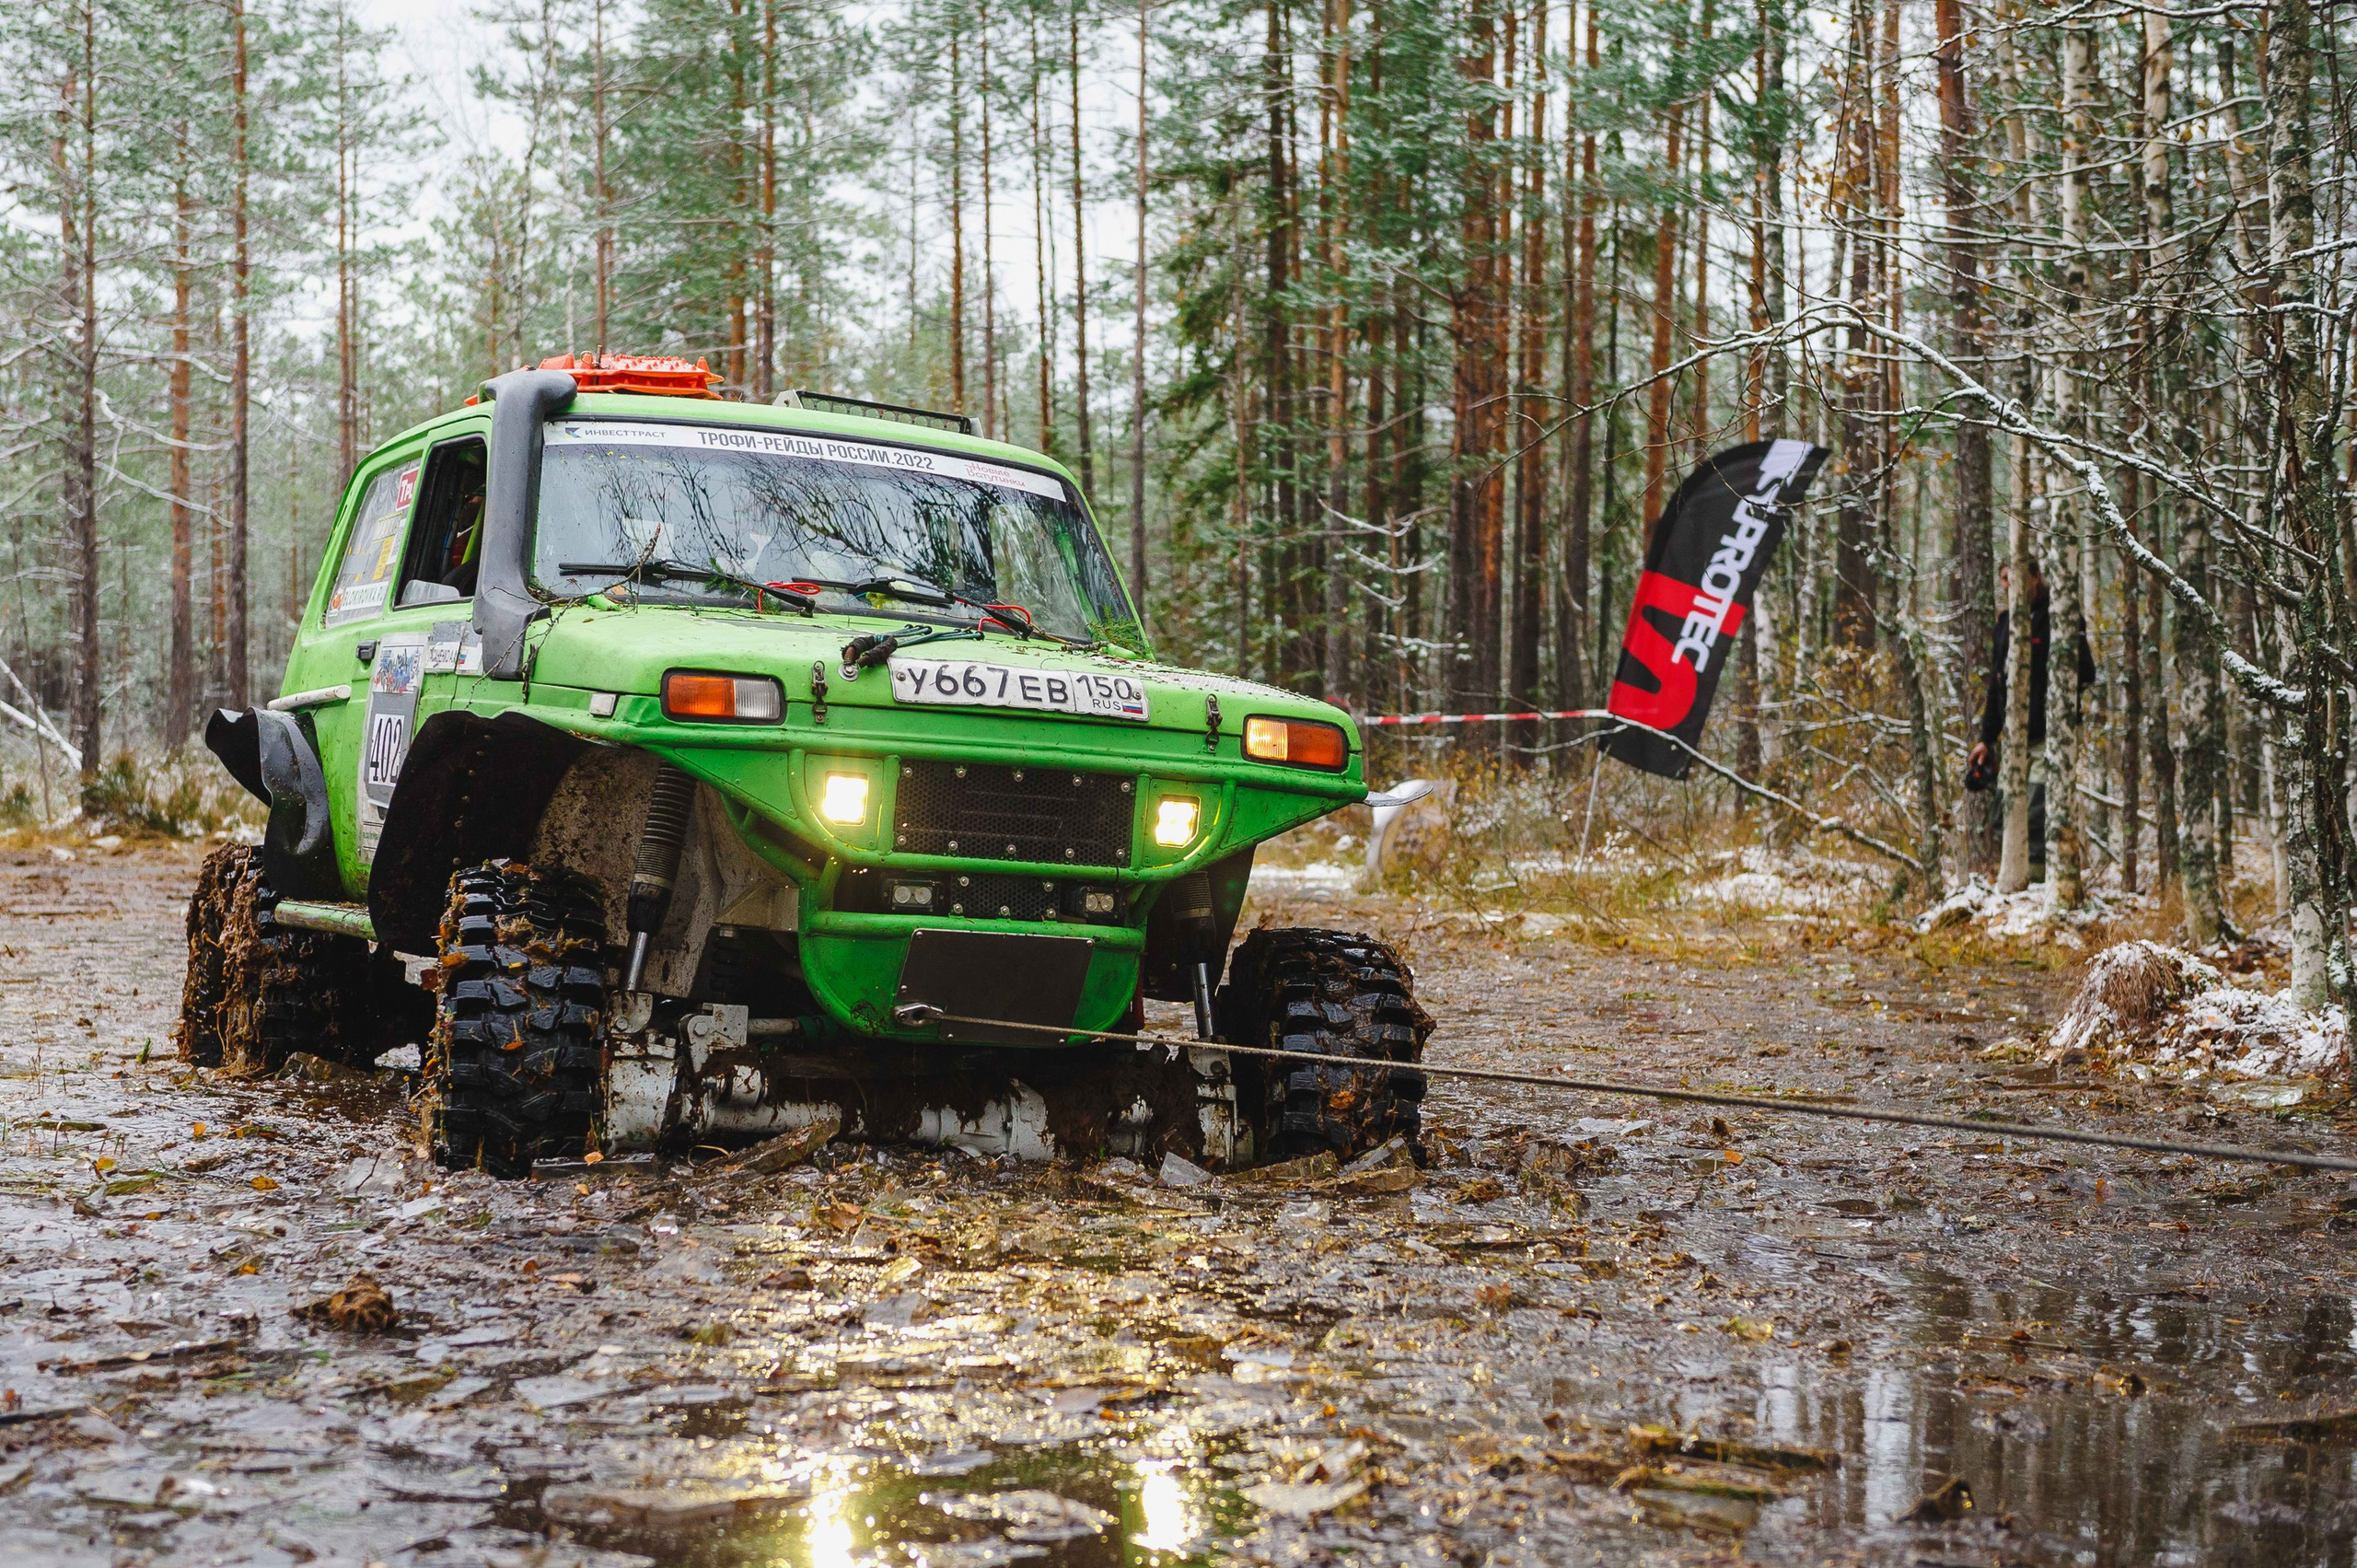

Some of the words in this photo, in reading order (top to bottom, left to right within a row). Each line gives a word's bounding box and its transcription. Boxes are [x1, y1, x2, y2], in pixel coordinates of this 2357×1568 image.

[585, 429, 666, 438] ИНВЕСТТРАСТ
[697, 431, 824, 456] ТРОФИ-РЕЙДЫ
[964, 463, 1010, 477] Новые
[1075, 674, 1132, 701] 150
[1092, 698, 1121, 711] RUS
[370, 717, 401, 783] 402
